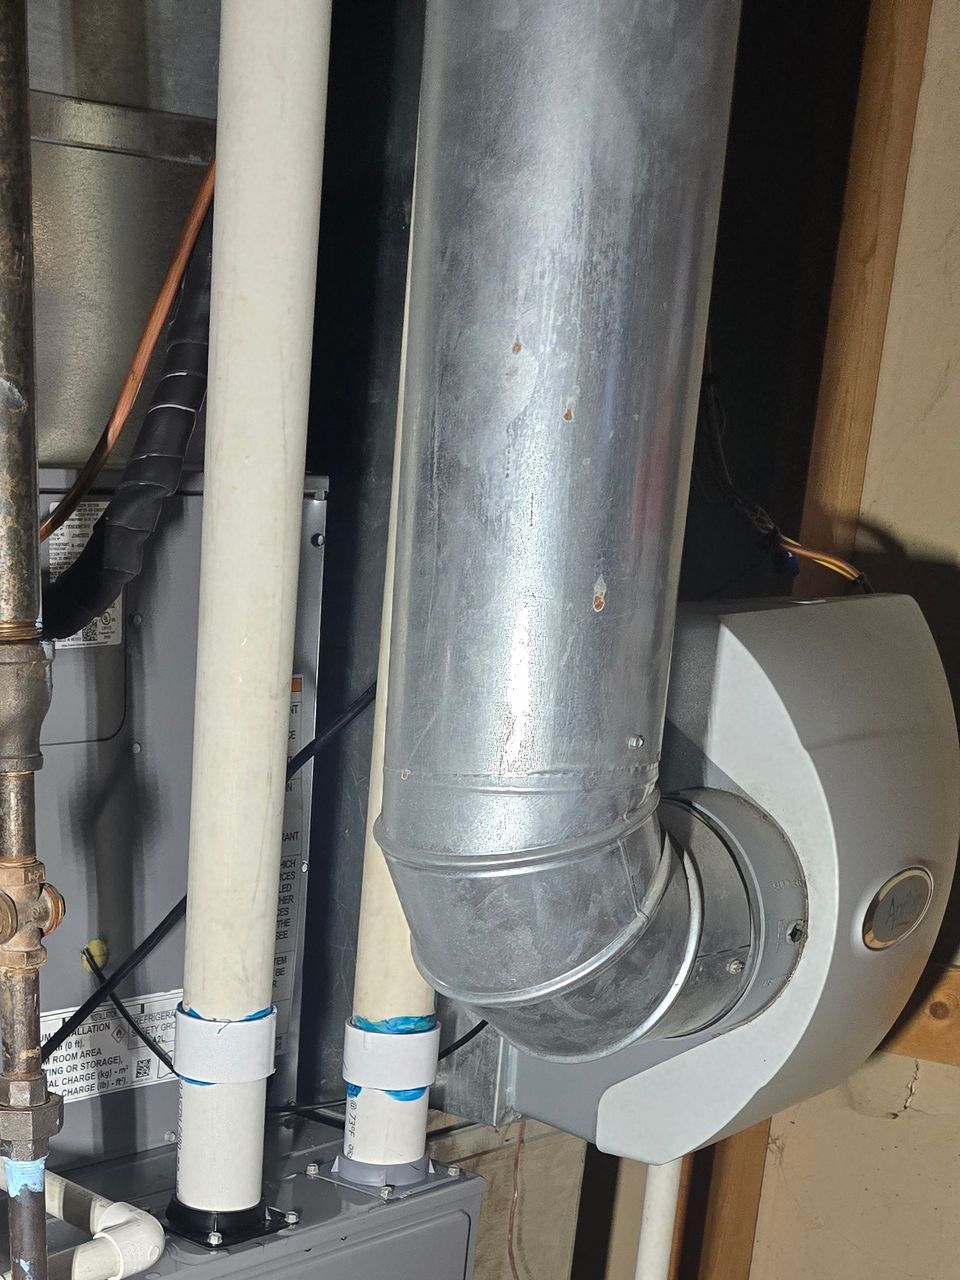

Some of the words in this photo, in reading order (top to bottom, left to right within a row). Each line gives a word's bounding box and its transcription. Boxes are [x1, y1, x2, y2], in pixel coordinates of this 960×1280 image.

[52, 1051, 78, 1064] ROOM
[80, 1047, 102, 1059] AREA
[66, 1064, 78, 1073] OR
[61, 1072, 96, 1086] CHARGE
[97, 1069, 112, 1079] (kg)
[61, 1083, 96, 1097] CHARGE
